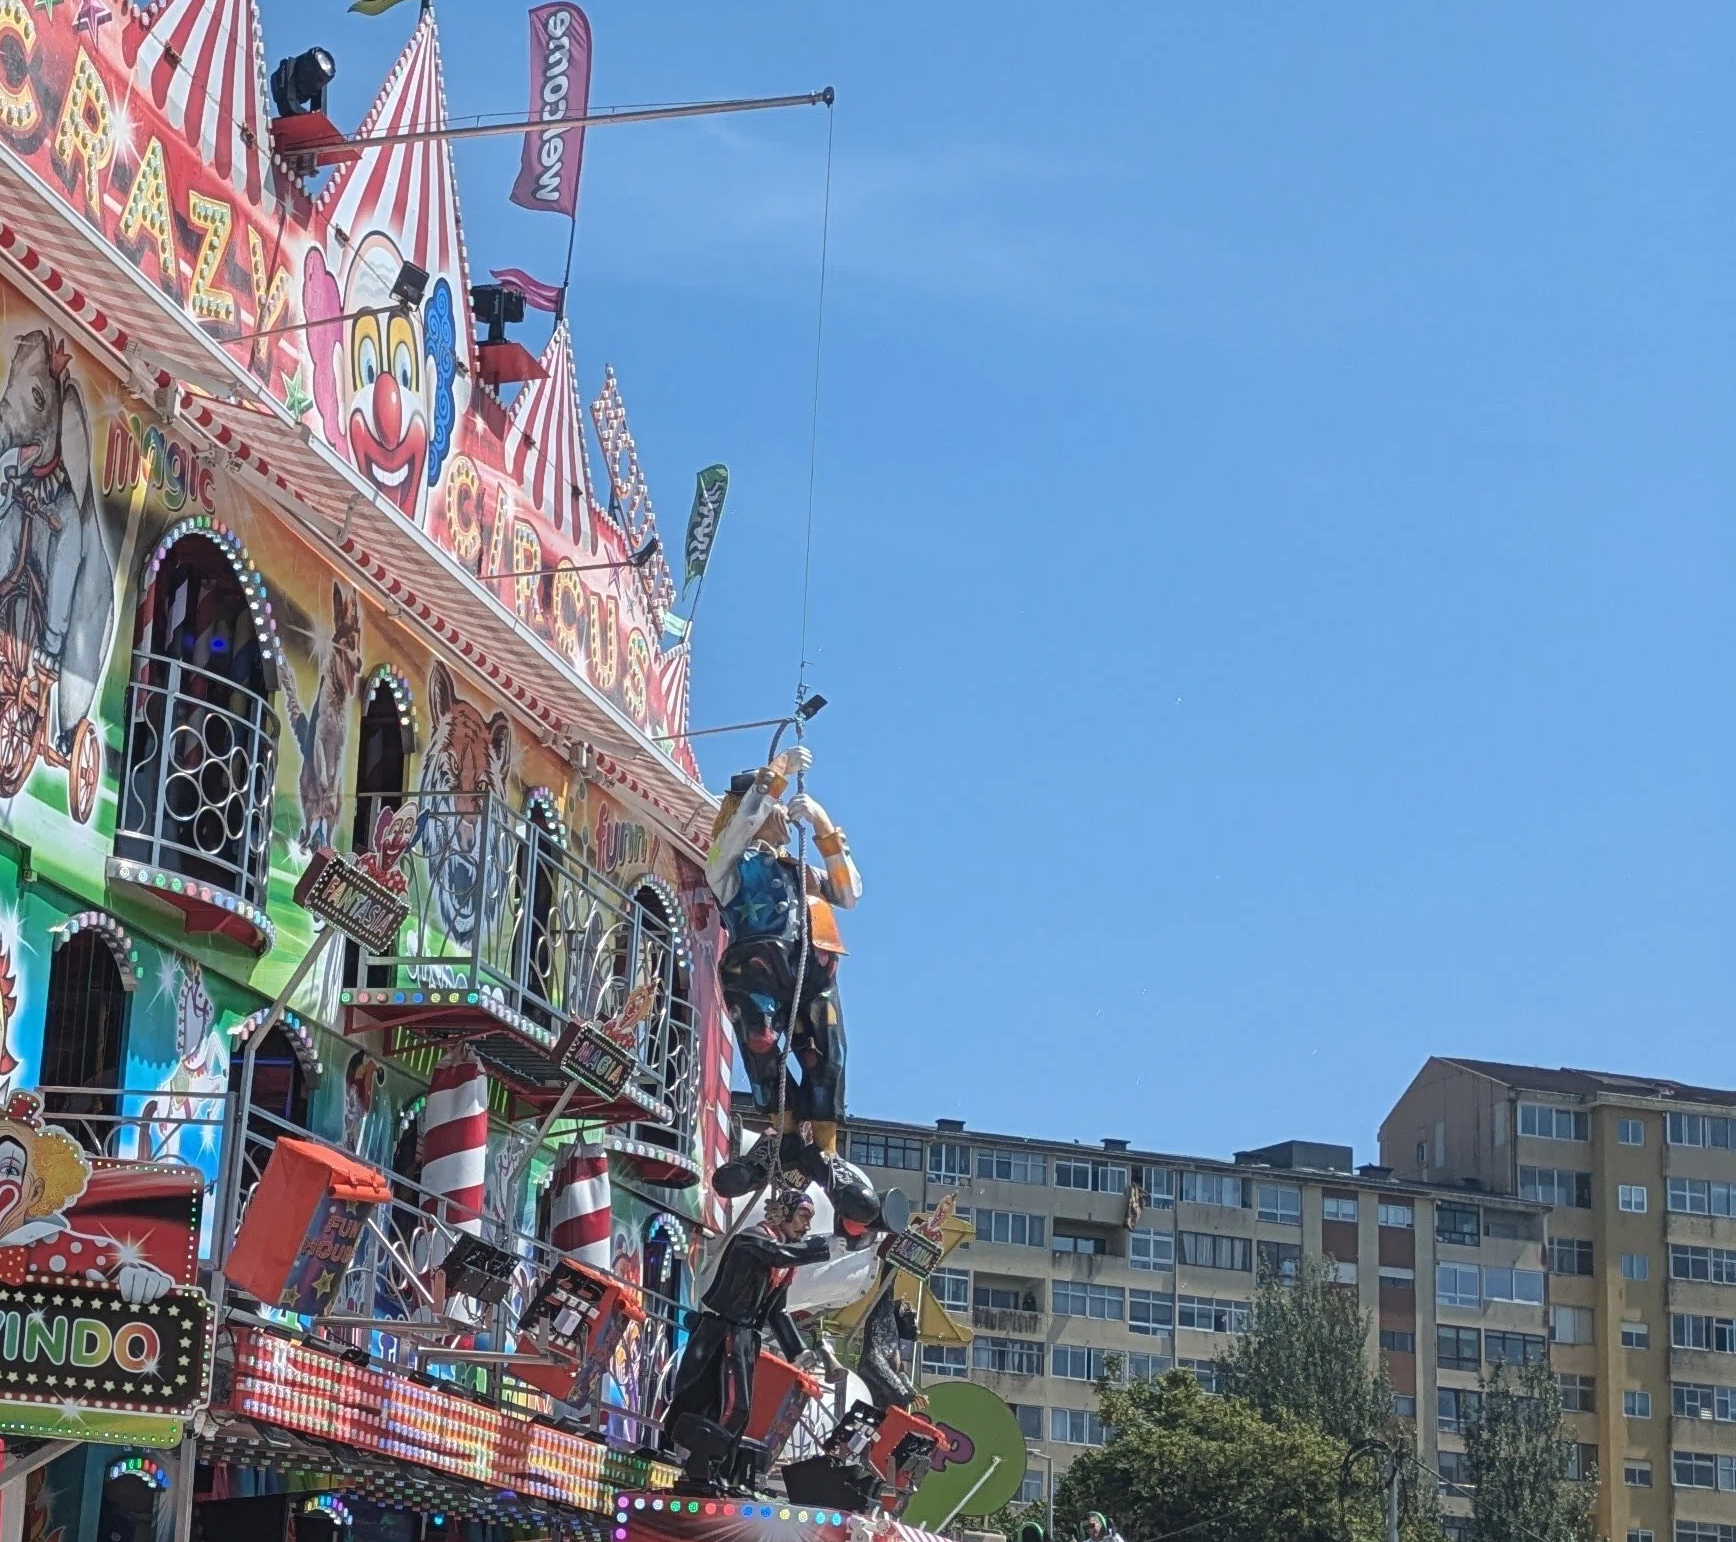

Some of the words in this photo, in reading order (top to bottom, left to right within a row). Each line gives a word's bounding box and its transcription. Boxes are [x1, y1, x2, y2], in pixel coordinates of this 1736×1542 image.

[102, 413, 217, 514] magic
[446, 455, 650, 721] CIRCUS
[322, 873, 395, 938] FANTASIA
[576, 1040, 621, 1087] MAGIA
